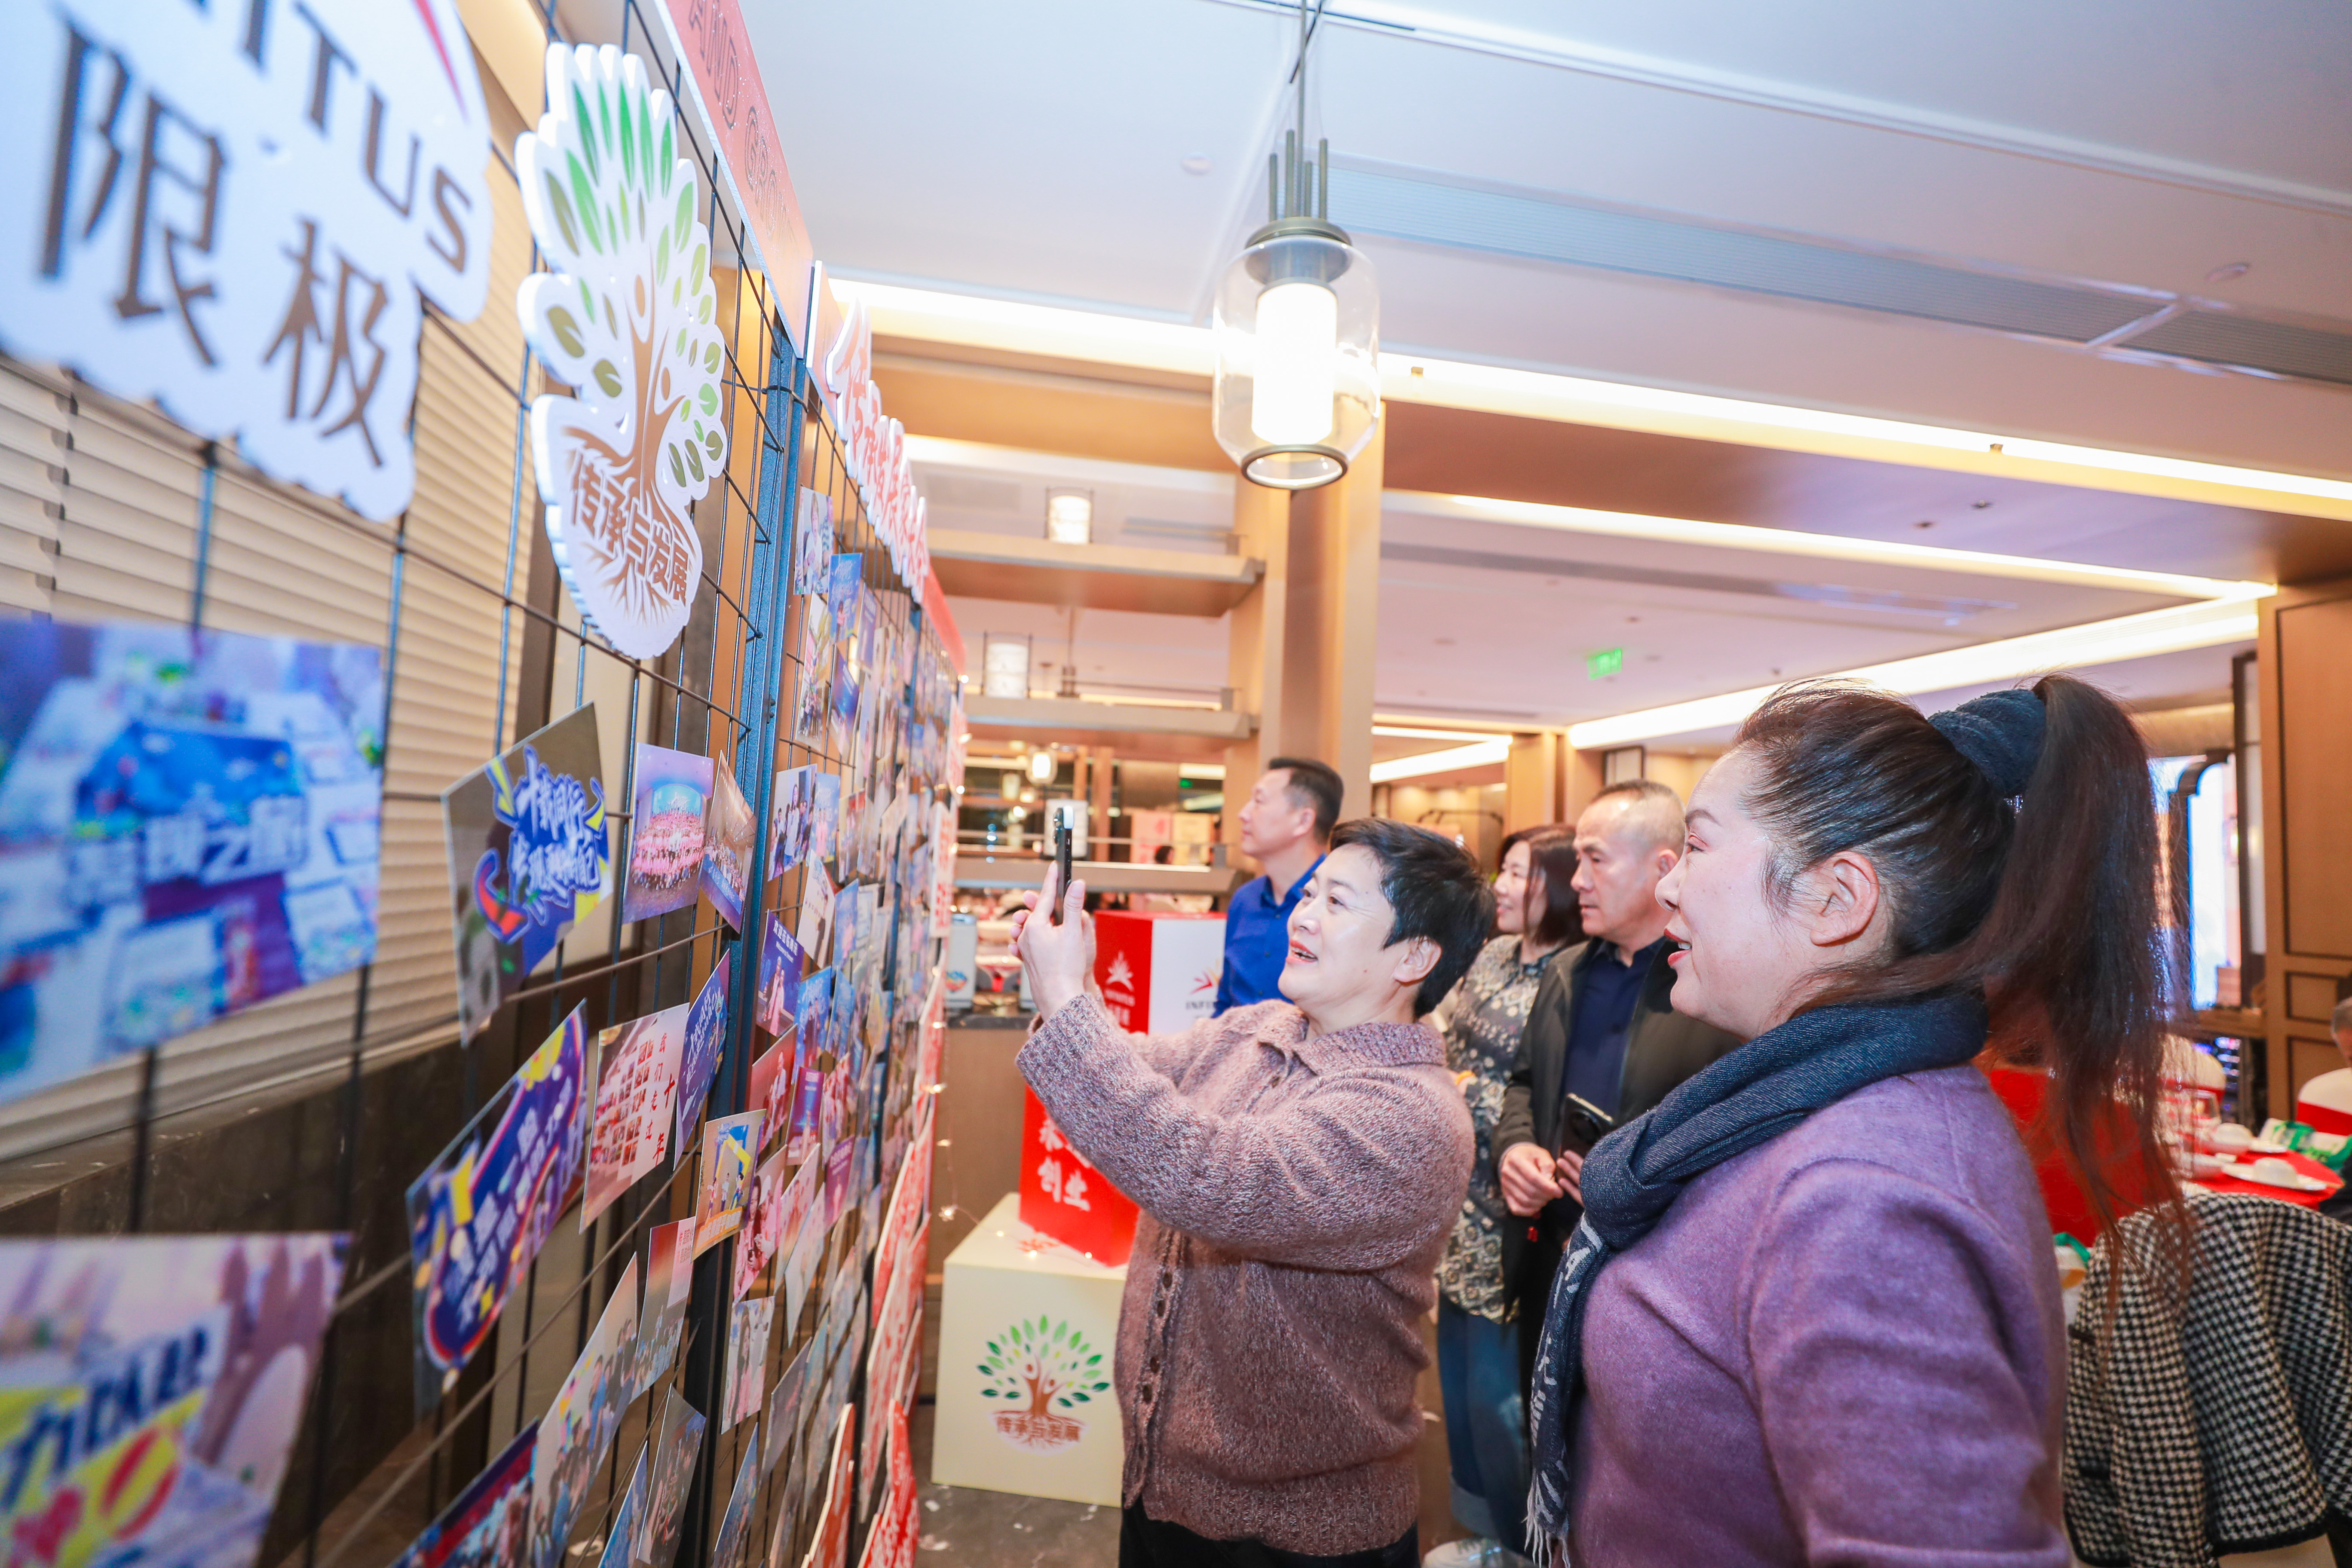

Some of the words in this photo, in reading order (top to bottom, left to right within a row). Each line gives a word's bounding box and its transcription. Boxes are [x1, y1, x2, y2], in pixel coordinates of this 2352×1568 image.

[571, 447, 689, 607] 传承与发展
[644, 1032, 667, 1140] 我们走过
[652, 1074, 675, 1166] 十年
